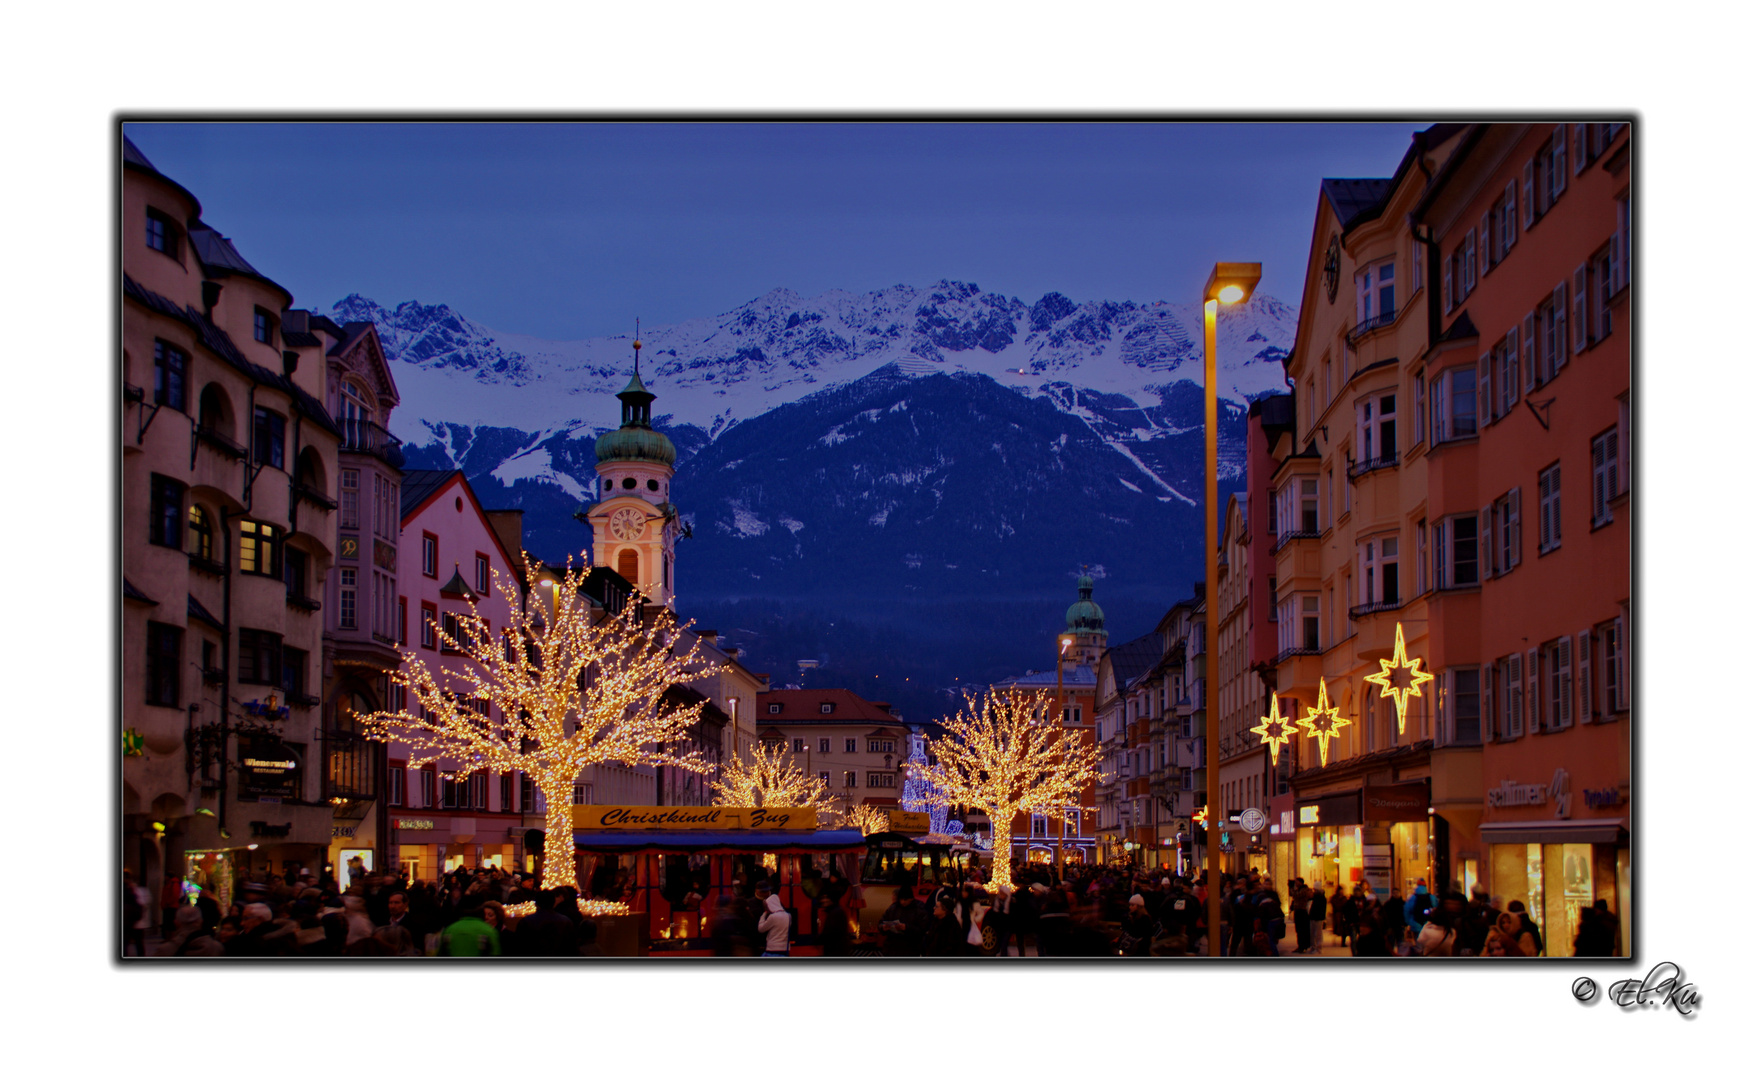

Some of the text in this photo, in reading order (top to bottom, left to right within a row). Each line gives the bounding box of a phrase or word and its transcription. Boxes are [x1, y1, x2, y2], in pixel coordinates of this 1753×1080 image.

[243, 758, 296, 769] Wienerwald
[252, 767, 286, 775] RESTAURANT
[1369, 798, 1421, 809] Weigand
[600, 809, 722, 826] Christkindl
[750, 809, 791, 828] Zug
